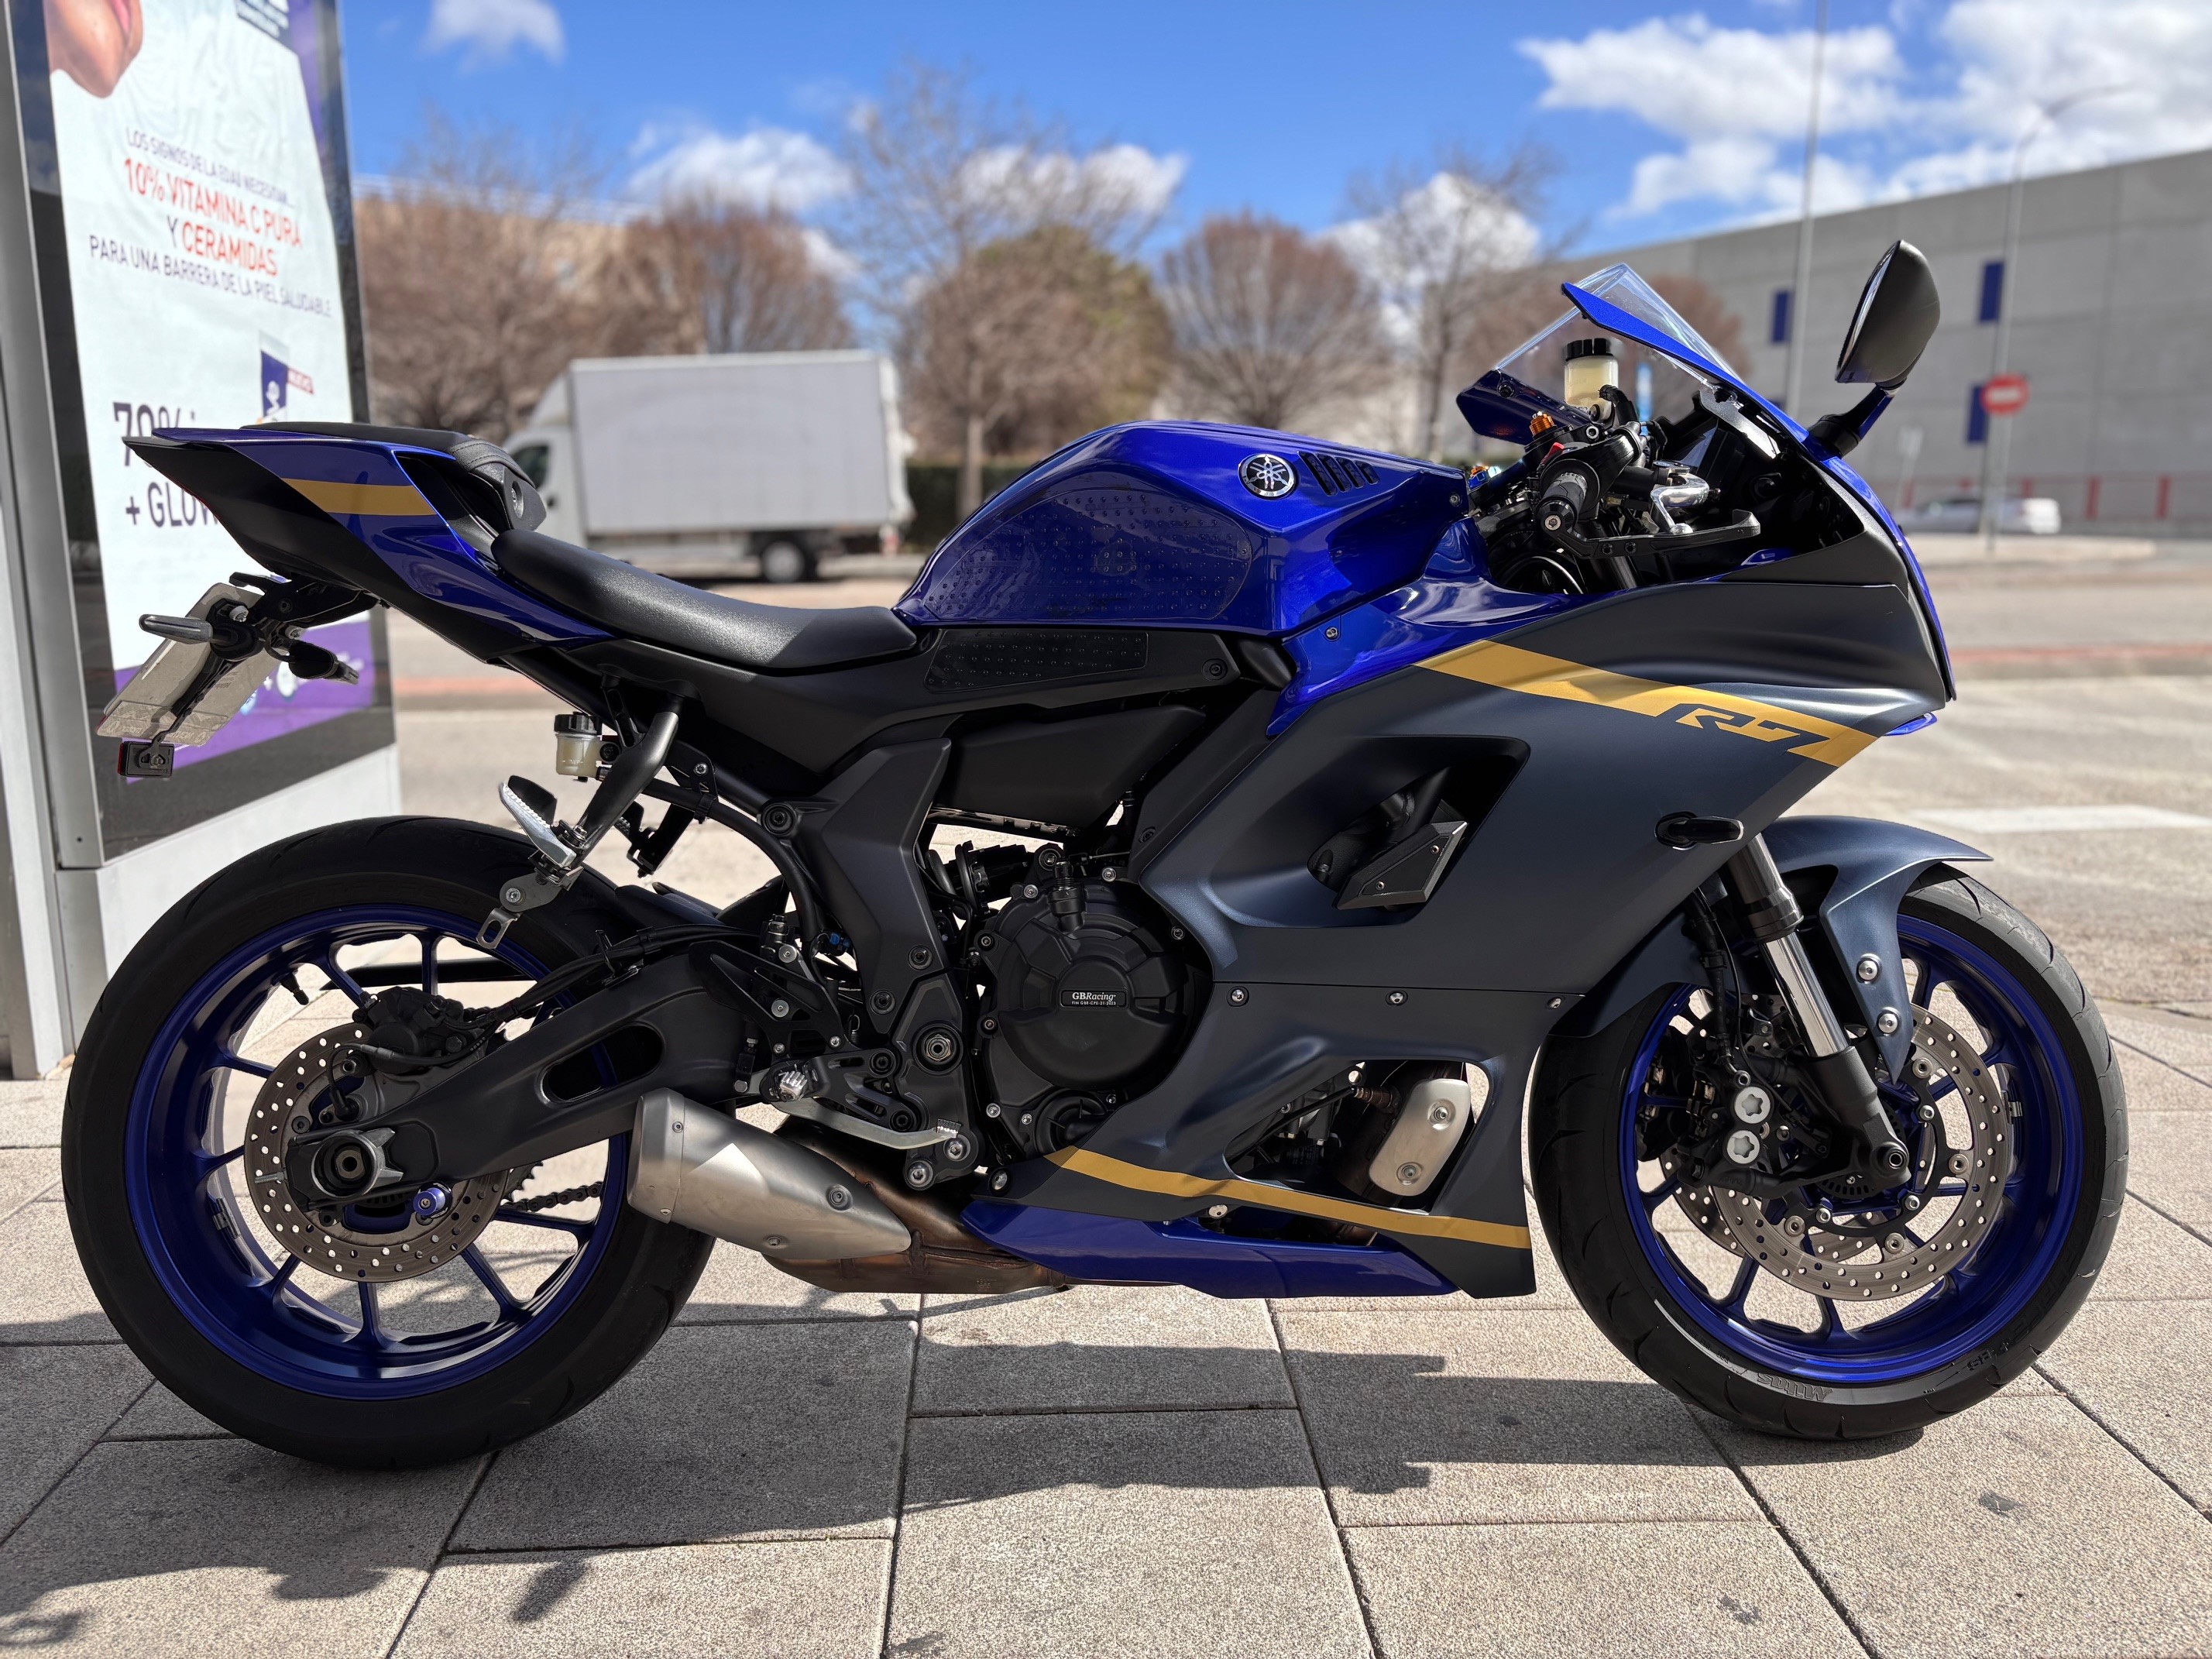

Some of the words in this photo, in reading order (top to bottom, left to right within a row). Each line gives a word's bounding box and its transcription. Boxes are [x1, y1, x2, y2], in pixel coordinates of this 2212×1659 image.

[125, 126, 148, 151] LOS
[125, 158, 165, 202] 10%
[167, 172, 249, 232] VITAMINA
[250, 204, 261, 234] C
[263, 208, 302, 249] PURA
[89, 234, 129, 266] PARA
[130, 245, 160, 274] UNA
[164, 254, 219, 287] BARRERA
[222, 271, 237, 294] DE
[239, 276, 252, 296] LA
[255, 280, 278, 304] PIEL
[167, 215, 177, 249] Y
[182, 222, 277, 276] CERAMIDAS
[1657, 703, 1830, 752] R7
[1072, 991, 1115, 1001] GBRacing
[1757, 1372, 1833, 1402] Mitas
